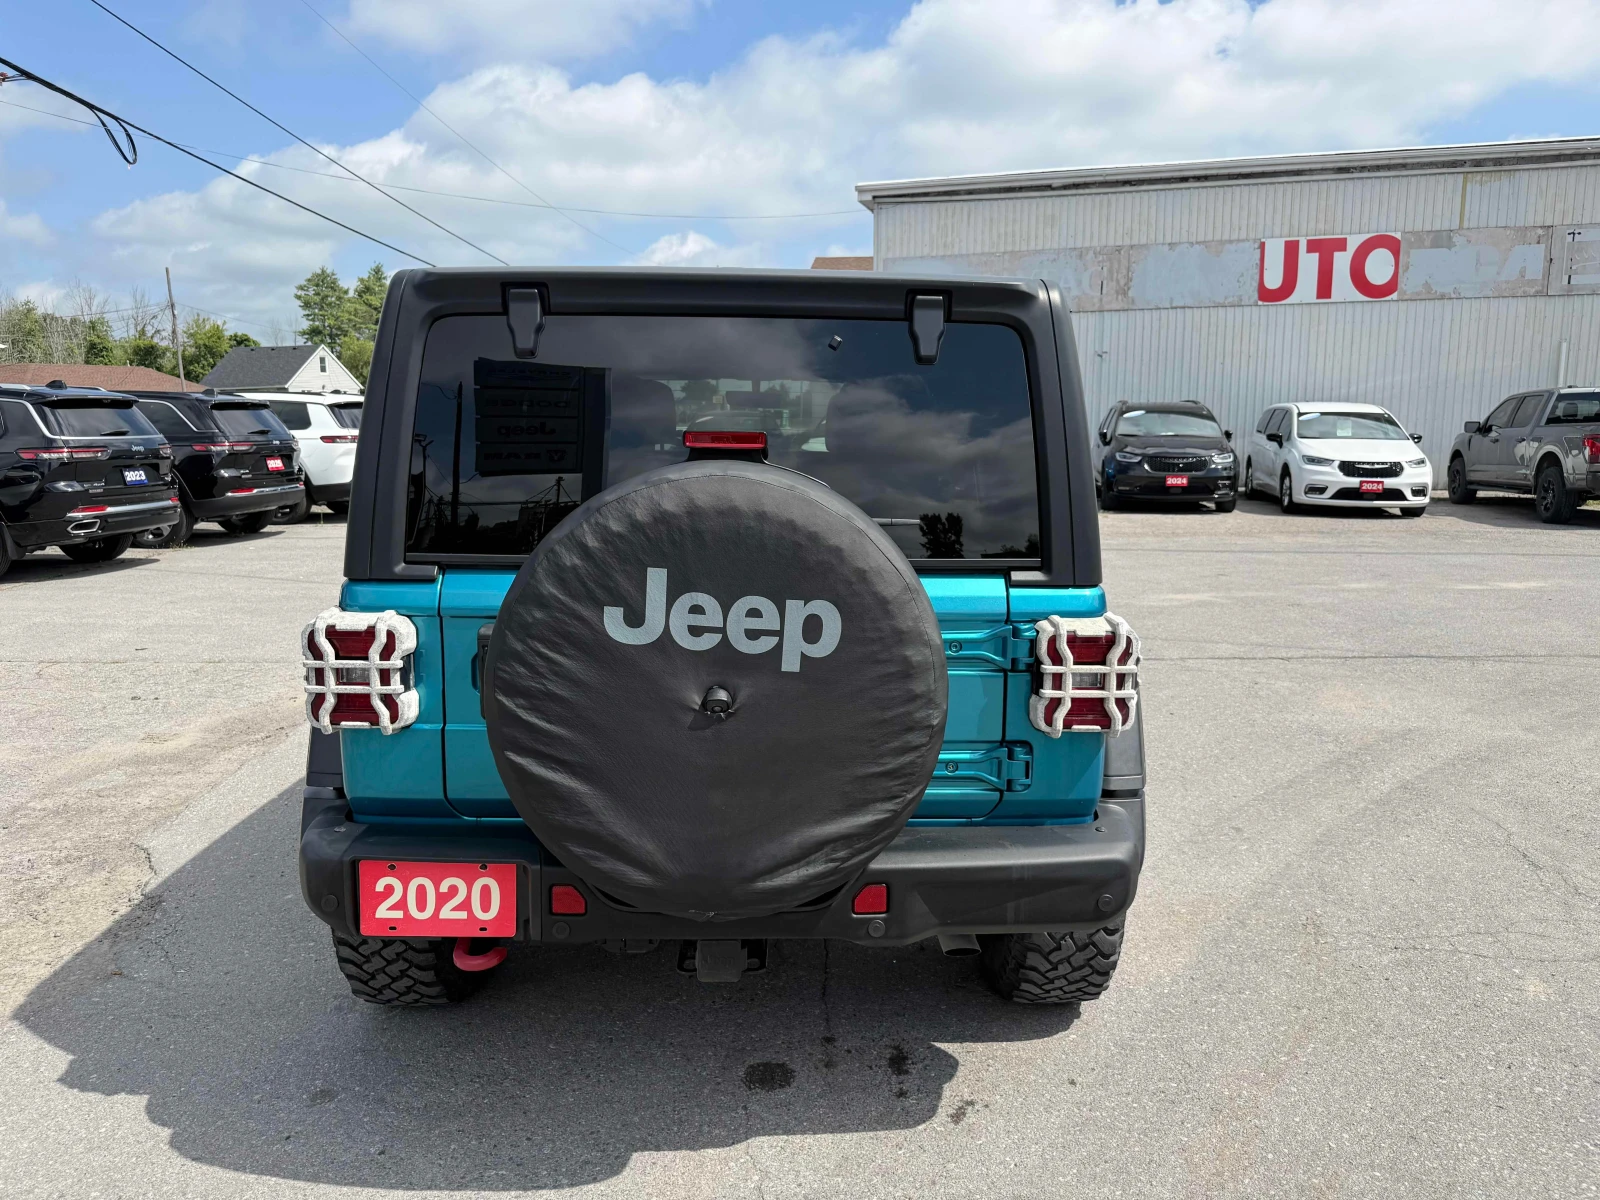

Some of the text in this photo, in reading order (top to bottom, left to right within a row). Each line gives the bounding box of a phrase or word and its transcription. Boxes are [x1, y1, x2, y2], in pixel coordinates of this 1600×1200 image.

[1258, 233, 1401, 303] UTO
[131, 444, 145, 452] Jeep
[124, 470, 146, 481] 2023
[1361, 482, 1383, 490] 2024
[603, 567, 842, 672] Jeep
[375, 876, 500, 920] 2020
